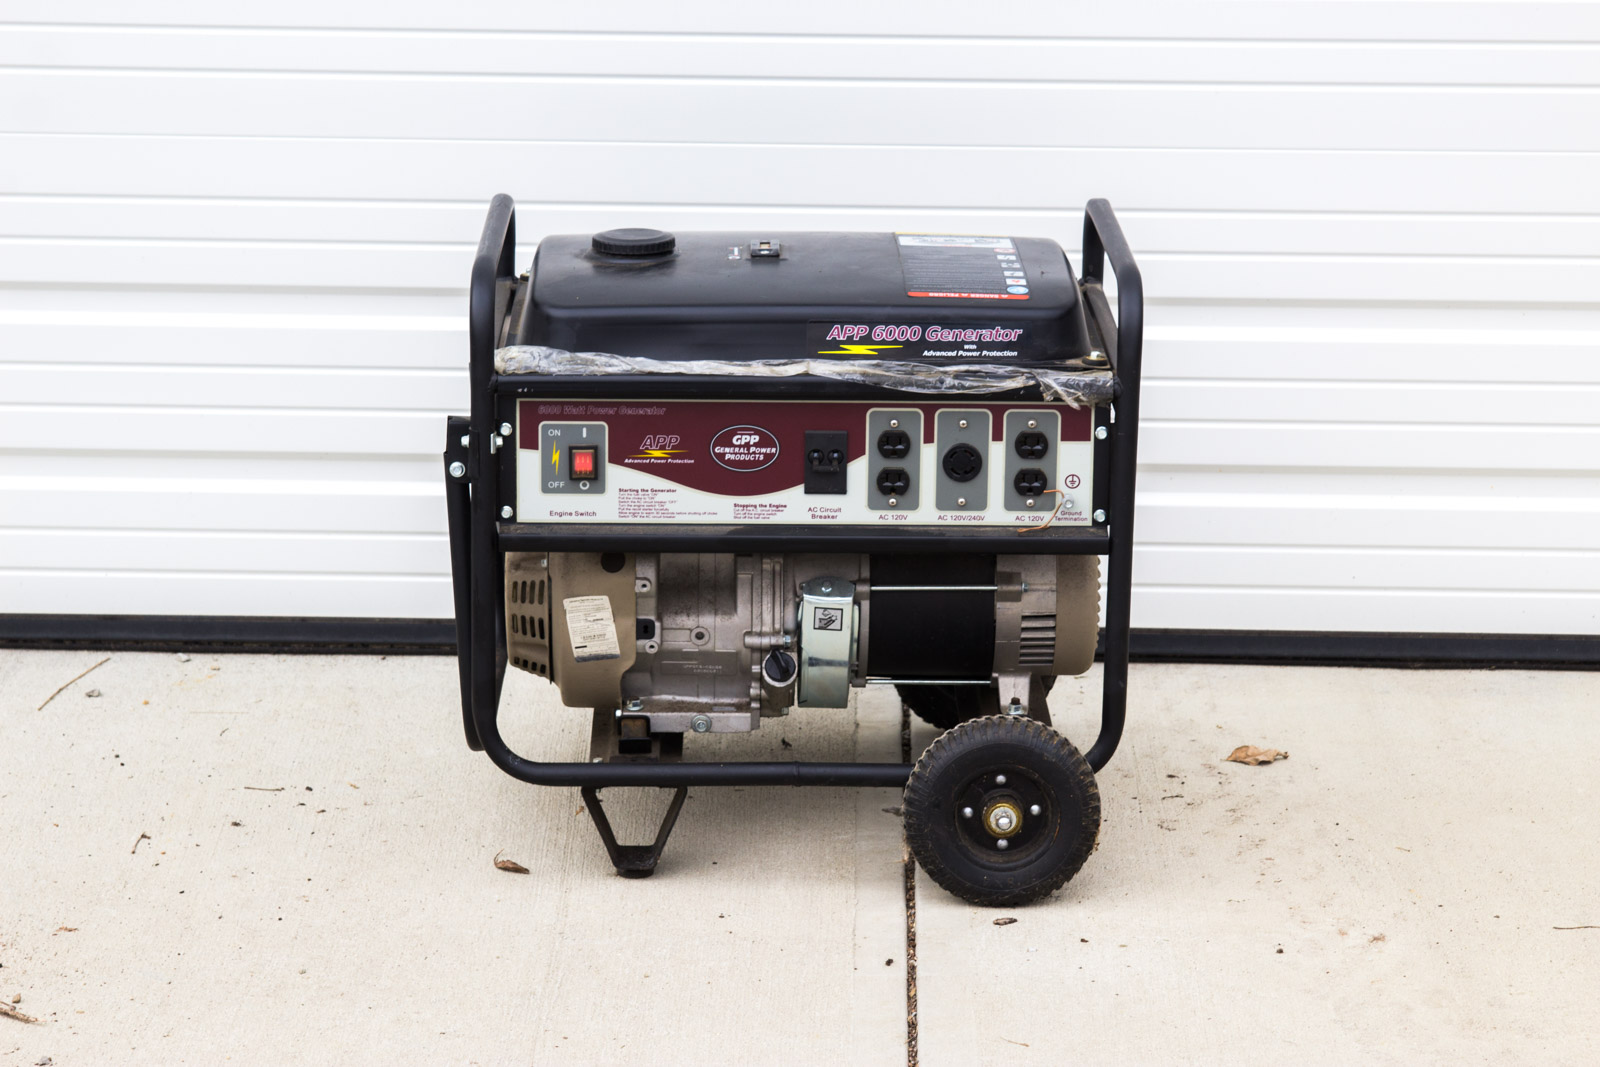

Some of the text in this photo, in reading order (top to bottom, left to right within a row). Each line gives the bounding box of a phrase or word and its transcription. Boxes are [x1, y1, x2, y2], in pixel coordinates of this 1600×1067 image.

[826, 325, 1023, 341] APP 6000 Generator
[538, 405, 666, 415] 6000 Watt Power Generator
[640, 435, 680, 449] APP
[732, 435, 760, 445] GPP
